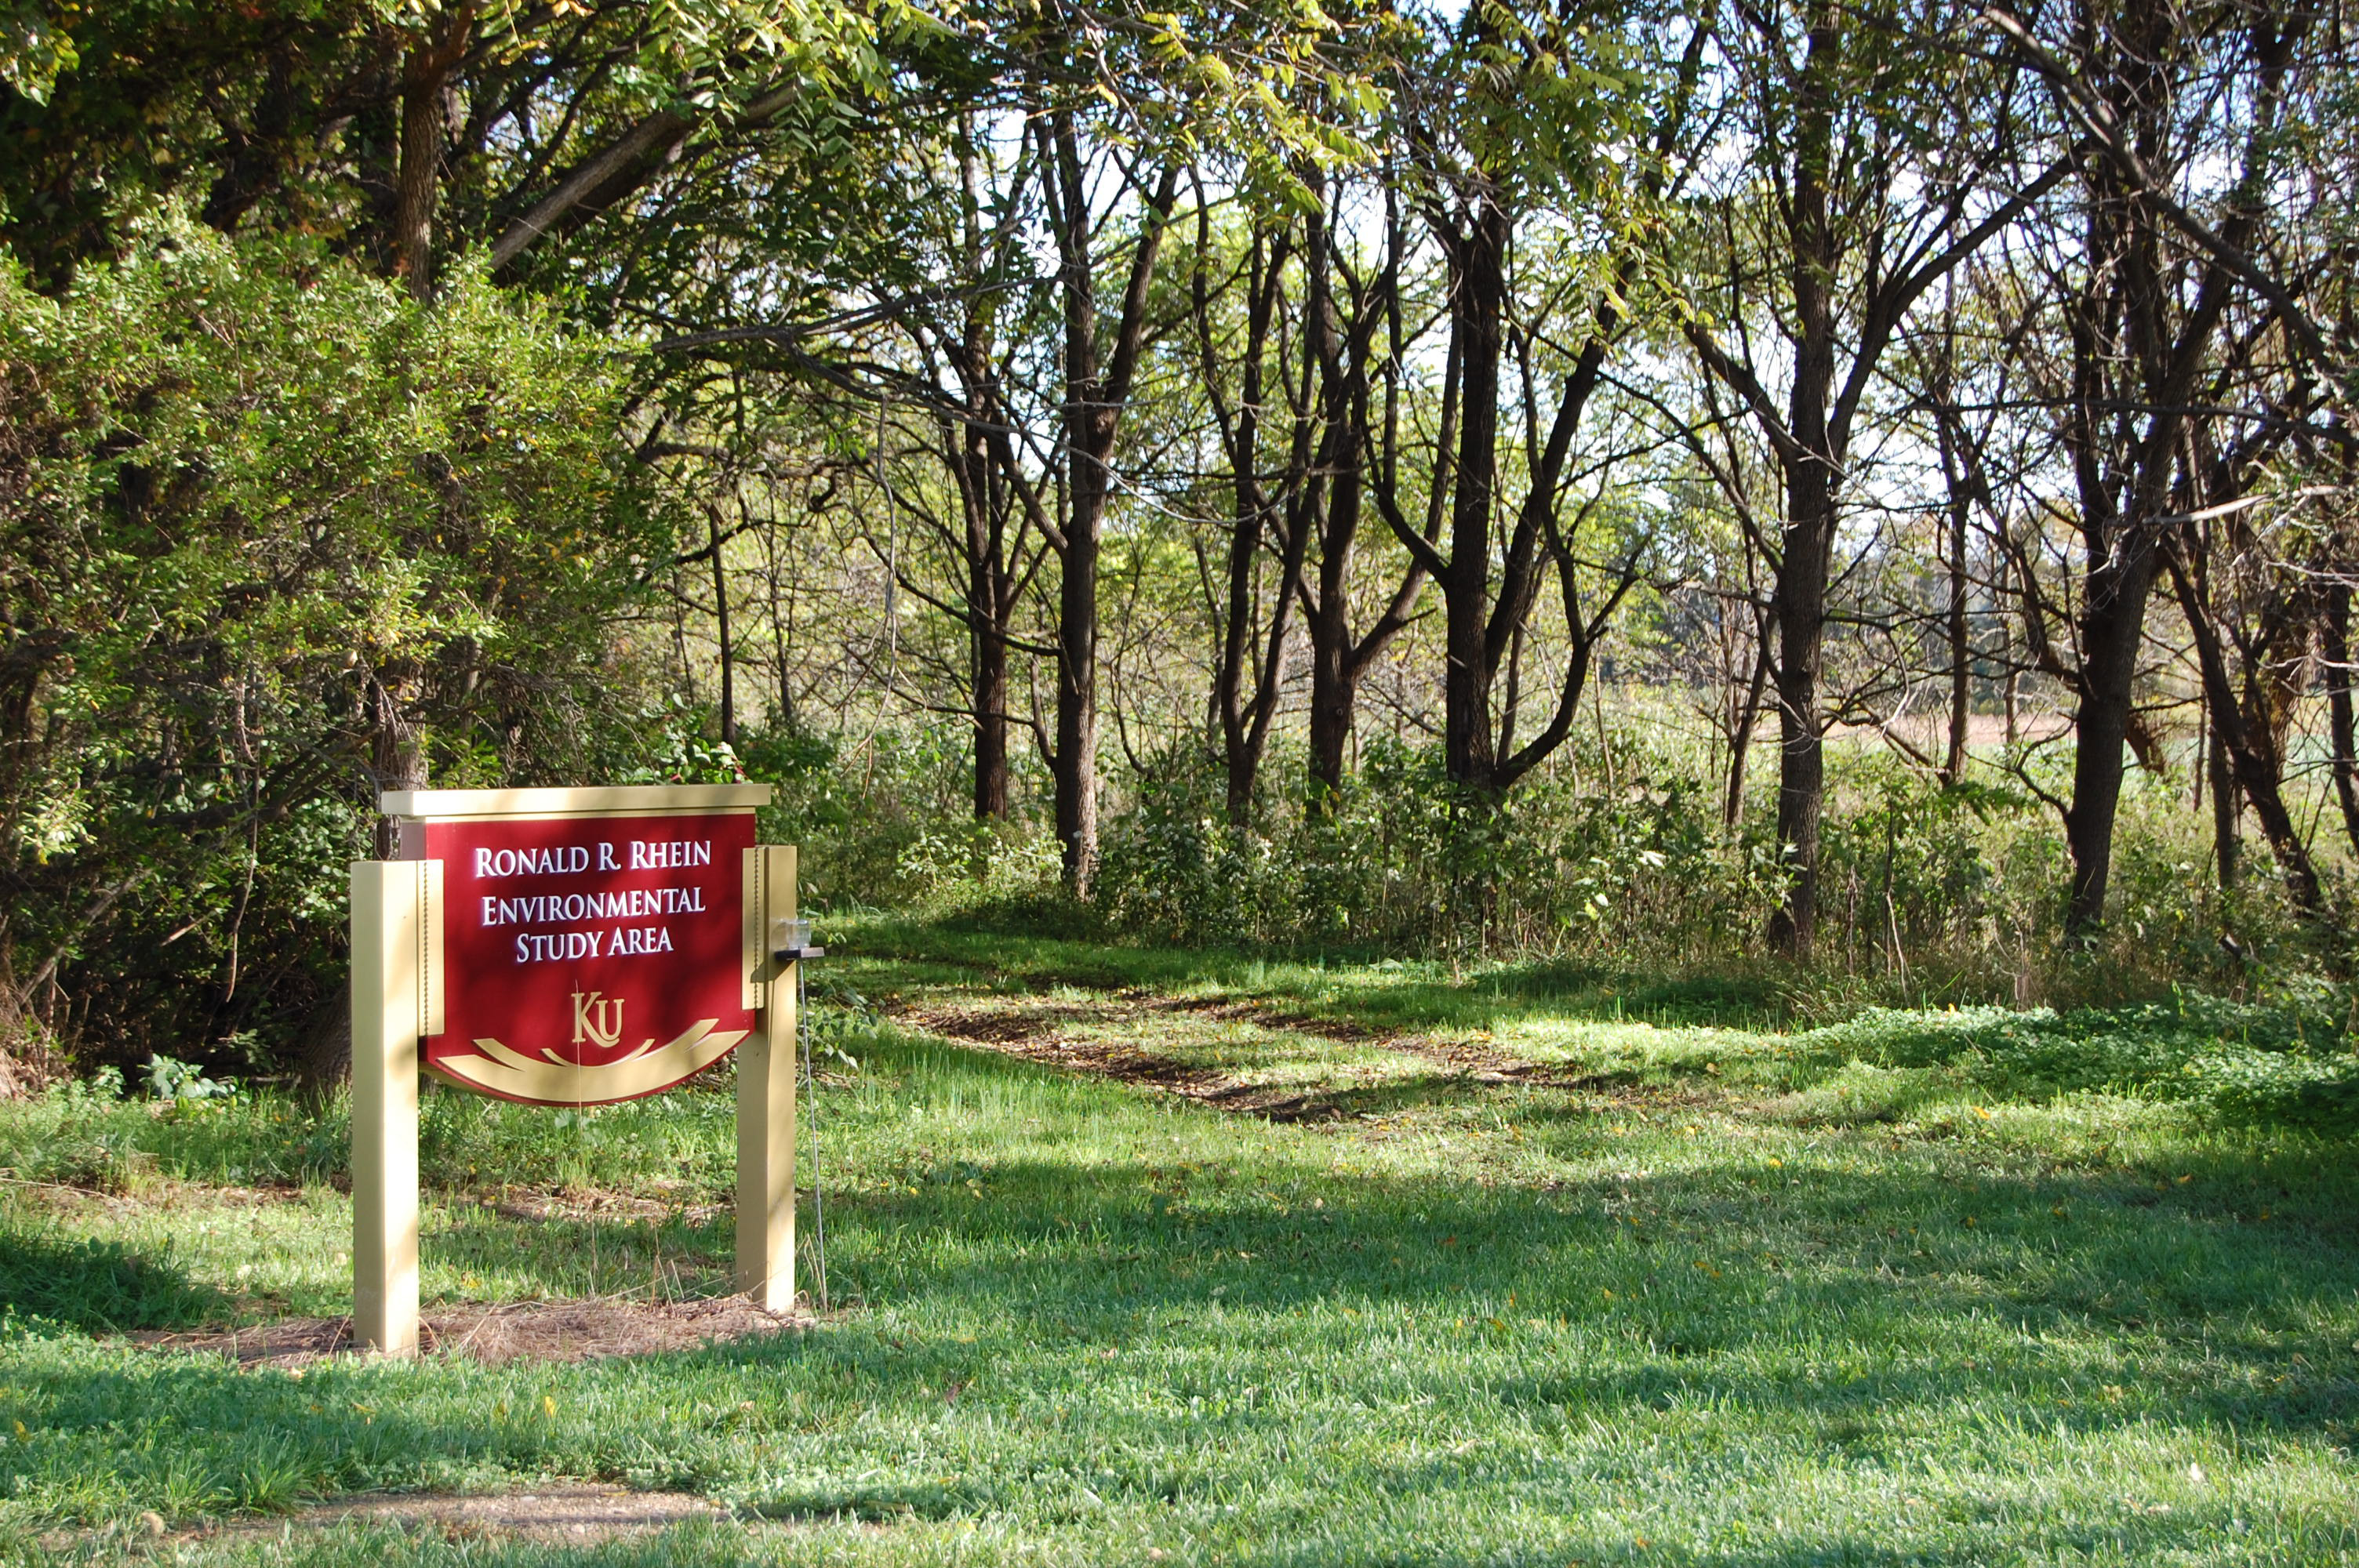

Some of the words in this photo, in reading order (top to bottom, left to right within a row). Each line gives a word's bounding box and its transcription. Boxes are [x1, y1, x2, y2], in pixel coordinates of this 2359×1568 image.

[474, 847, 589, 879] RONALD
[599, 842, 621, 871] R.
[631, 840, 711, 870] RHEIN
[482, 887, 706, 926] ENVIRONMENTAL
[516, 931, 605, 963] STUDY
[608, 926, 673, 956] AREA
[571, 991, 625, 1048] KU
